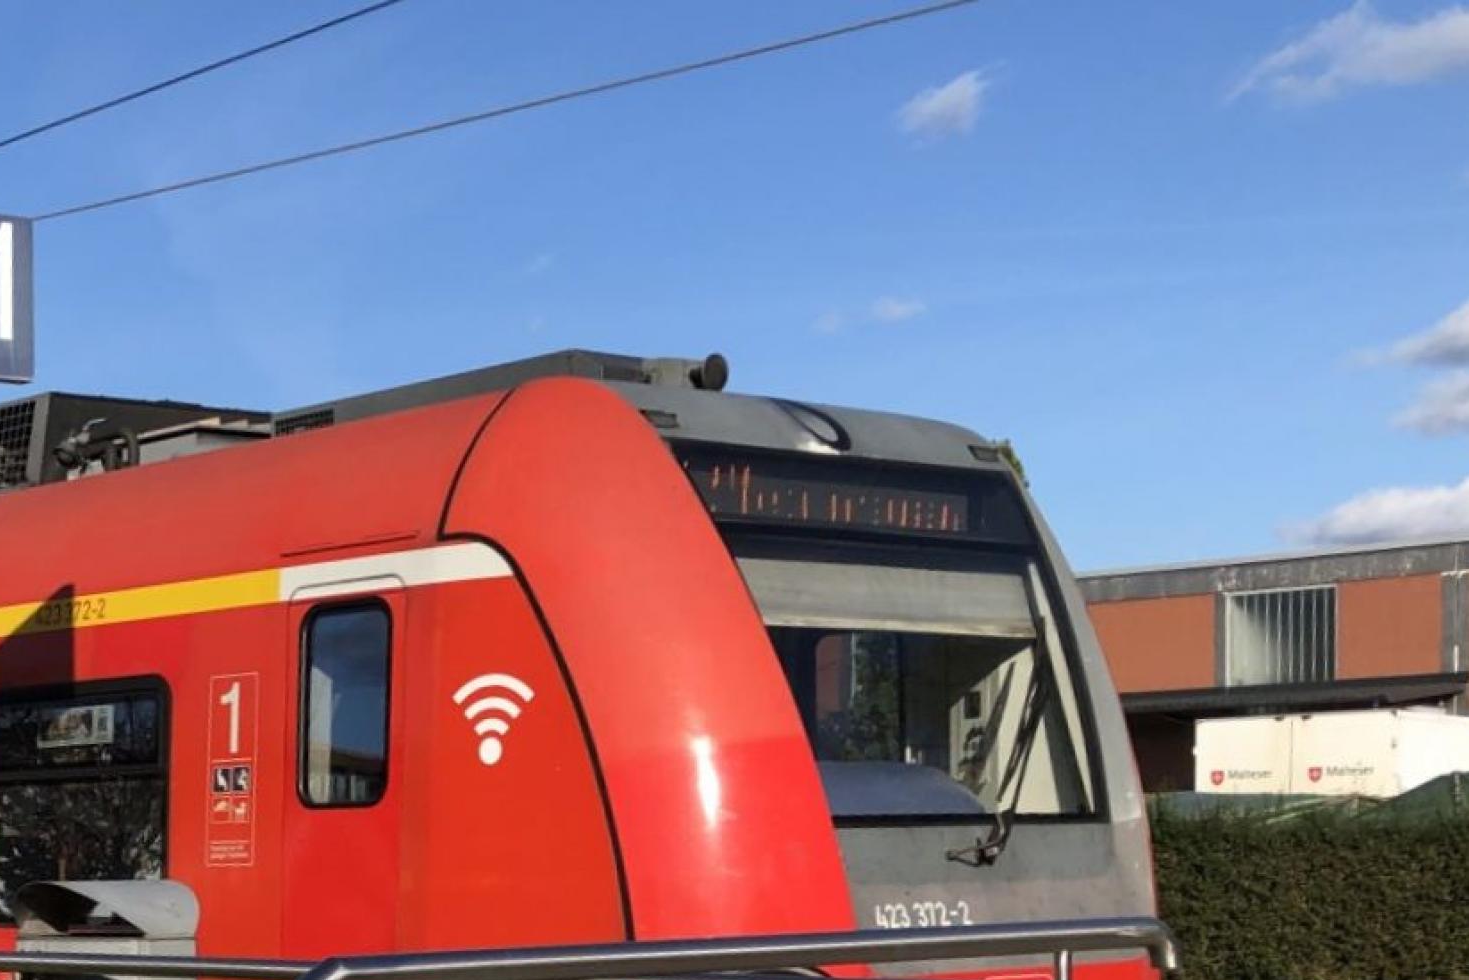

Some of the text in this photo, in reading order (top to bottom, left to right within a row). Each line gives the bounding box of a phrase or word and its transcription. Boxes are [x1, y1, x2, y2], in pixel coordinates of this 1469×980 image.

[220, 681, 241, 754] 1
[875, 901, 973, 928] 423 372-2
